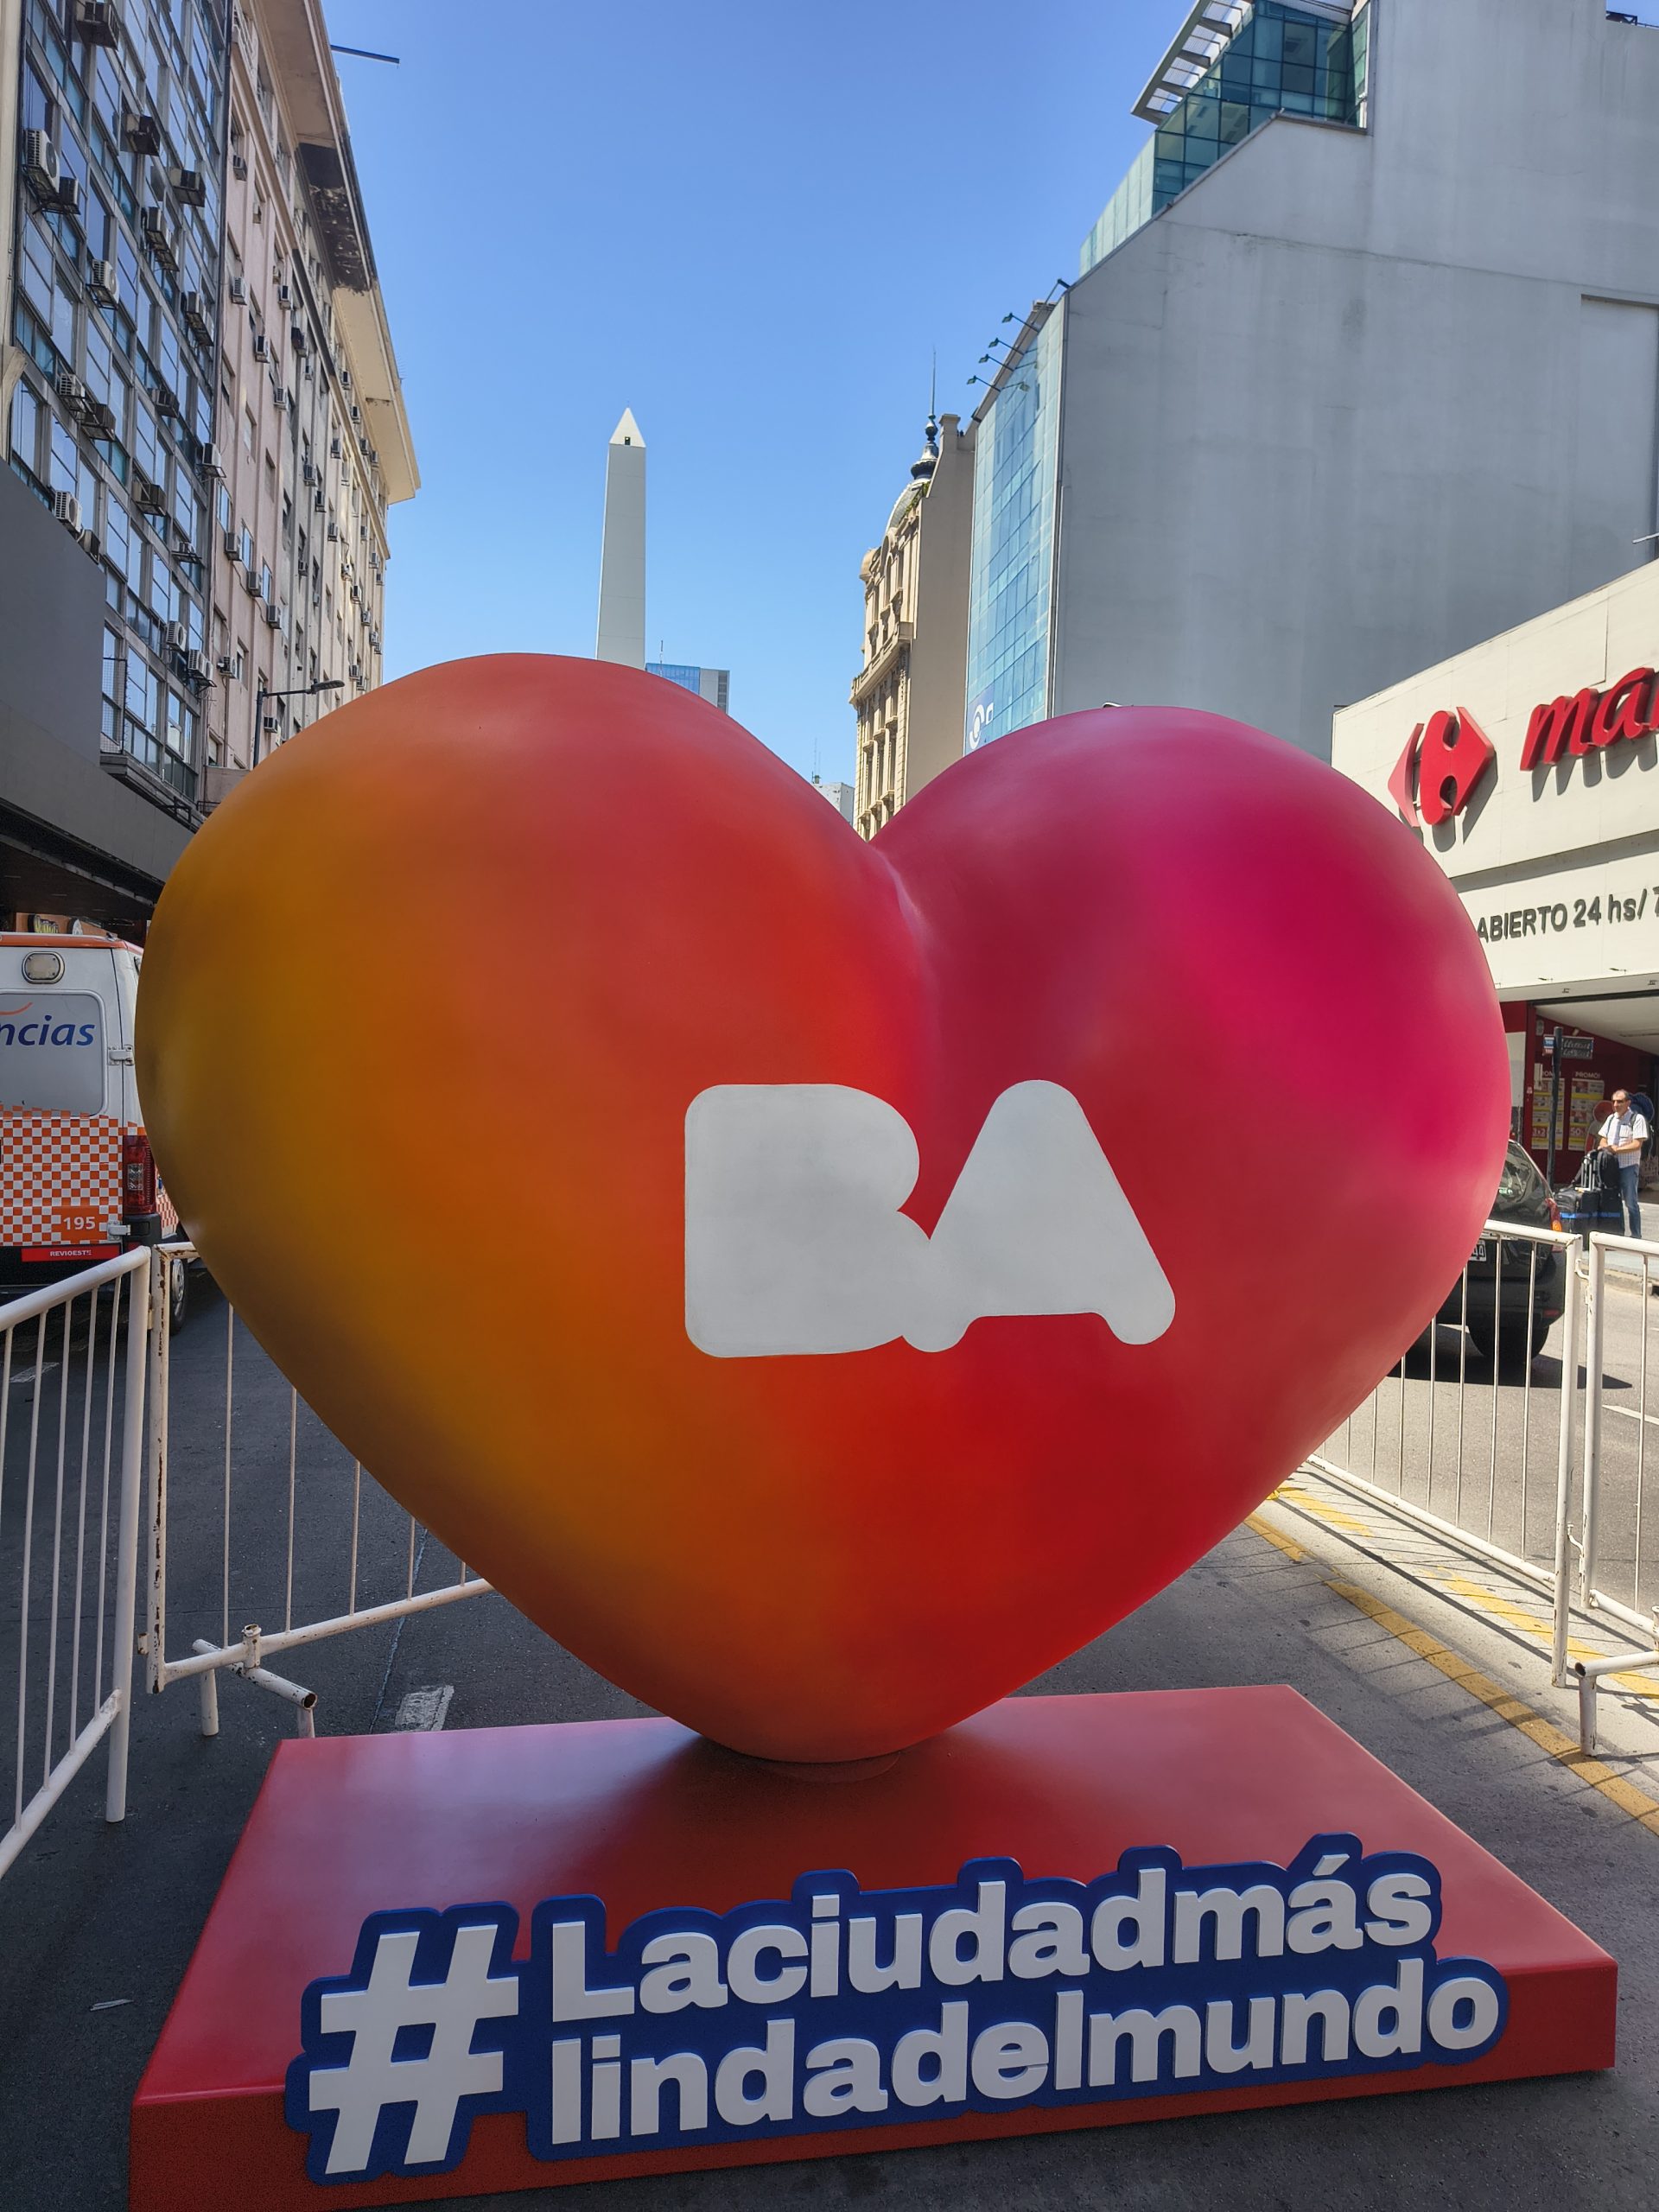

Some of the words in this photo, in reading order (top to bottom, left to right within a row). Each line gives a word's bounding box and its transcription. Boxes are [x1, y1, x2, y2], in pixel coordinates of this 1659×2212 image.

[1477, 903, 1567, 943] ABIERTO
[1573, 896, 1601, 928] 24
[63, 1217, 96, 1230] 195
[684, 1079, 1176, 1358] BA
[552, 1958, 1499, 2145] lindadelmundo
